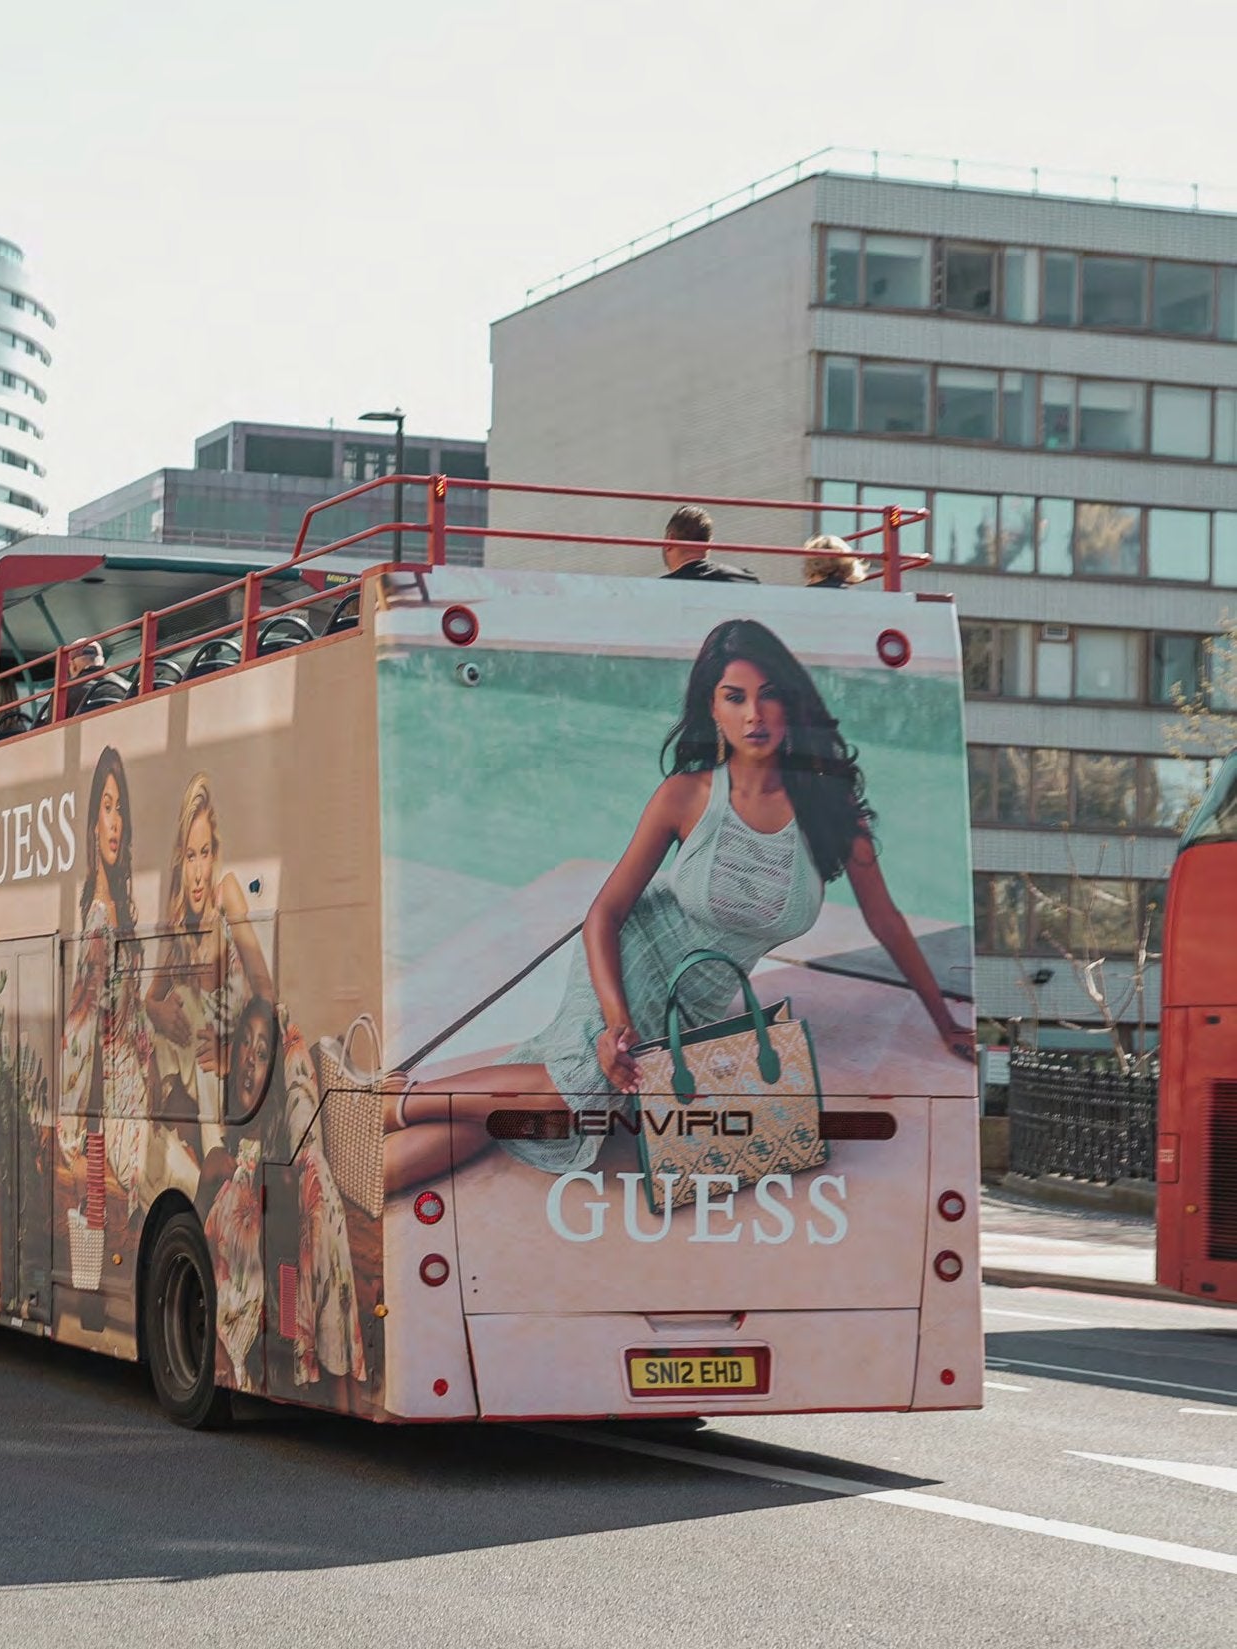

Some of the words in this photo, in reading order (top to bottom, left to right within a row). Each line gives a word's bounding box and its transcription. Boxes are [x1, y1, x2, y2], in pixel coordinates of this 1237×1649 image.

[575, 1109, 754, 1136] ENVIRO
[546, 1171, 849, 1244] GUESS
[645, 1361, 695, 1384] SN12
[700, 1360, 743, 1383] EHD
